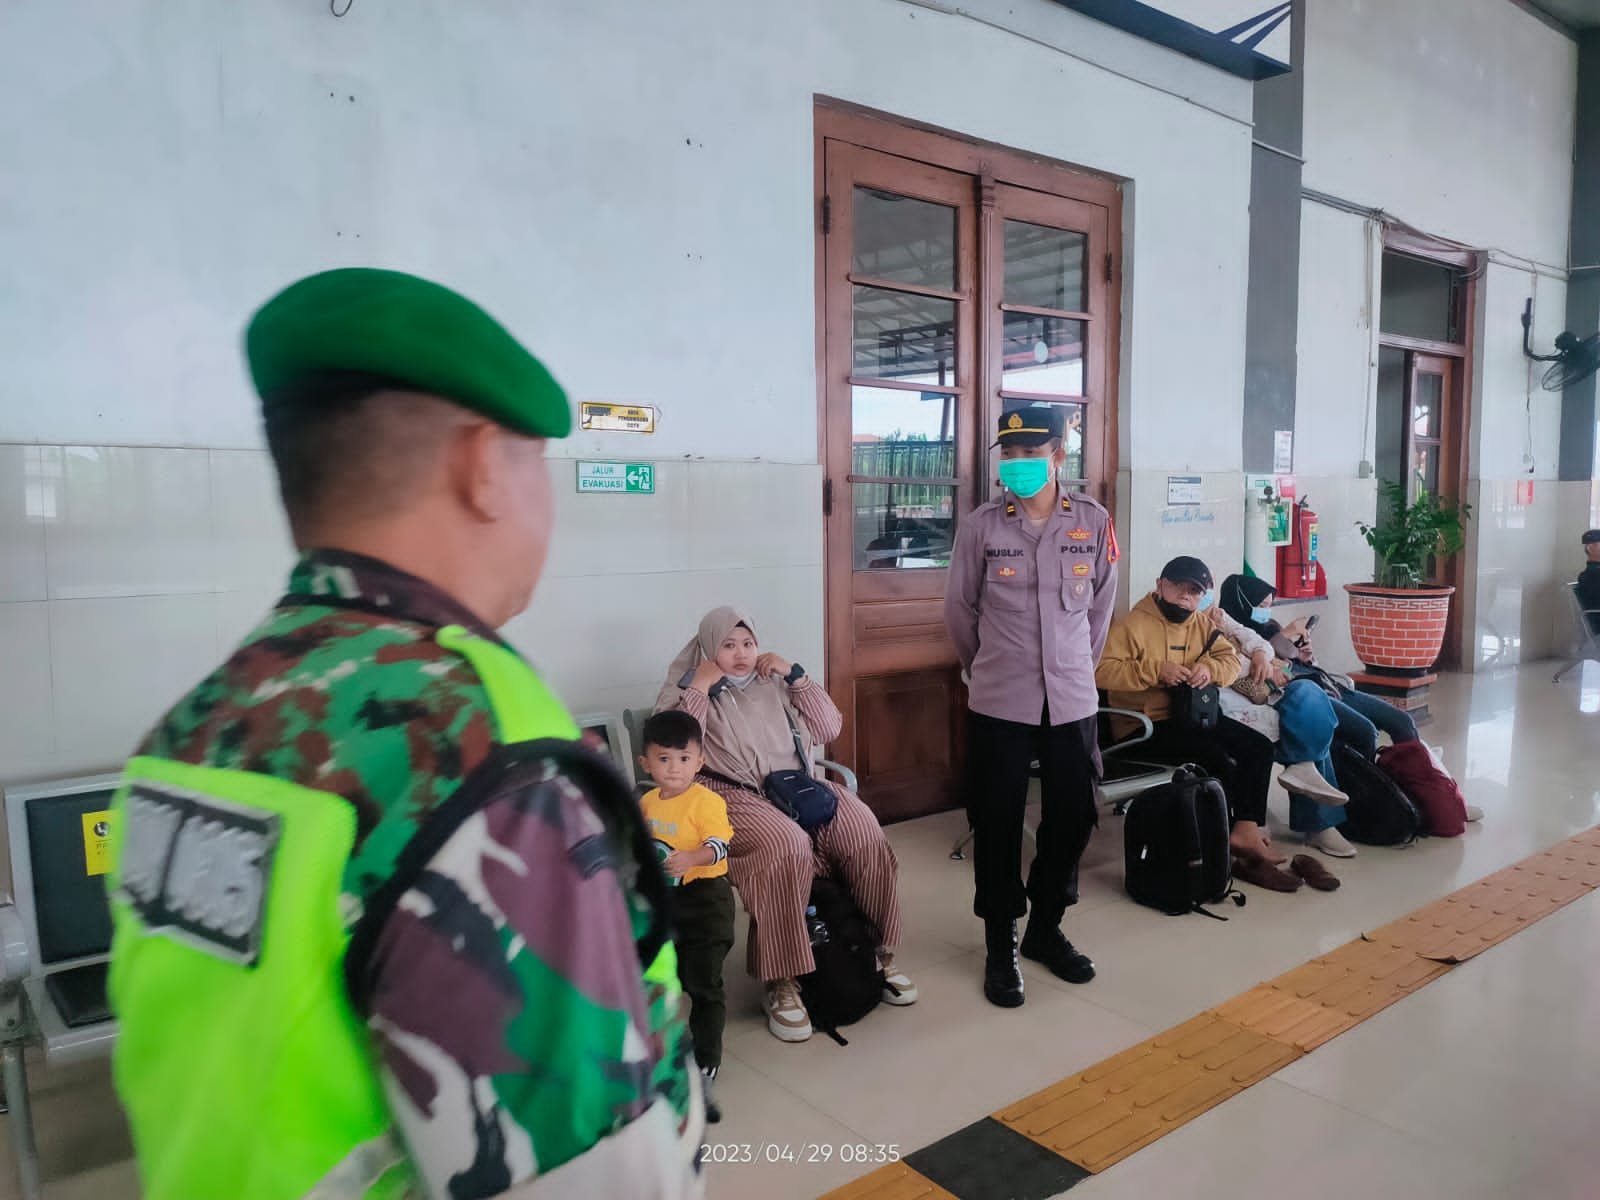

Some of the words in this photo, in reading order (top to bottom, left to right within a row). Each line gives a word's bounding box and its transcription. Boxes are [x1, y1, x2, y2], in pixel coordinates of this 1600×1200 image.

[592, 466, 614, 475] JALUR
[582, 479, 623, 488] EVAKUASI
[1060, 544, 1096, 554] POLRI
